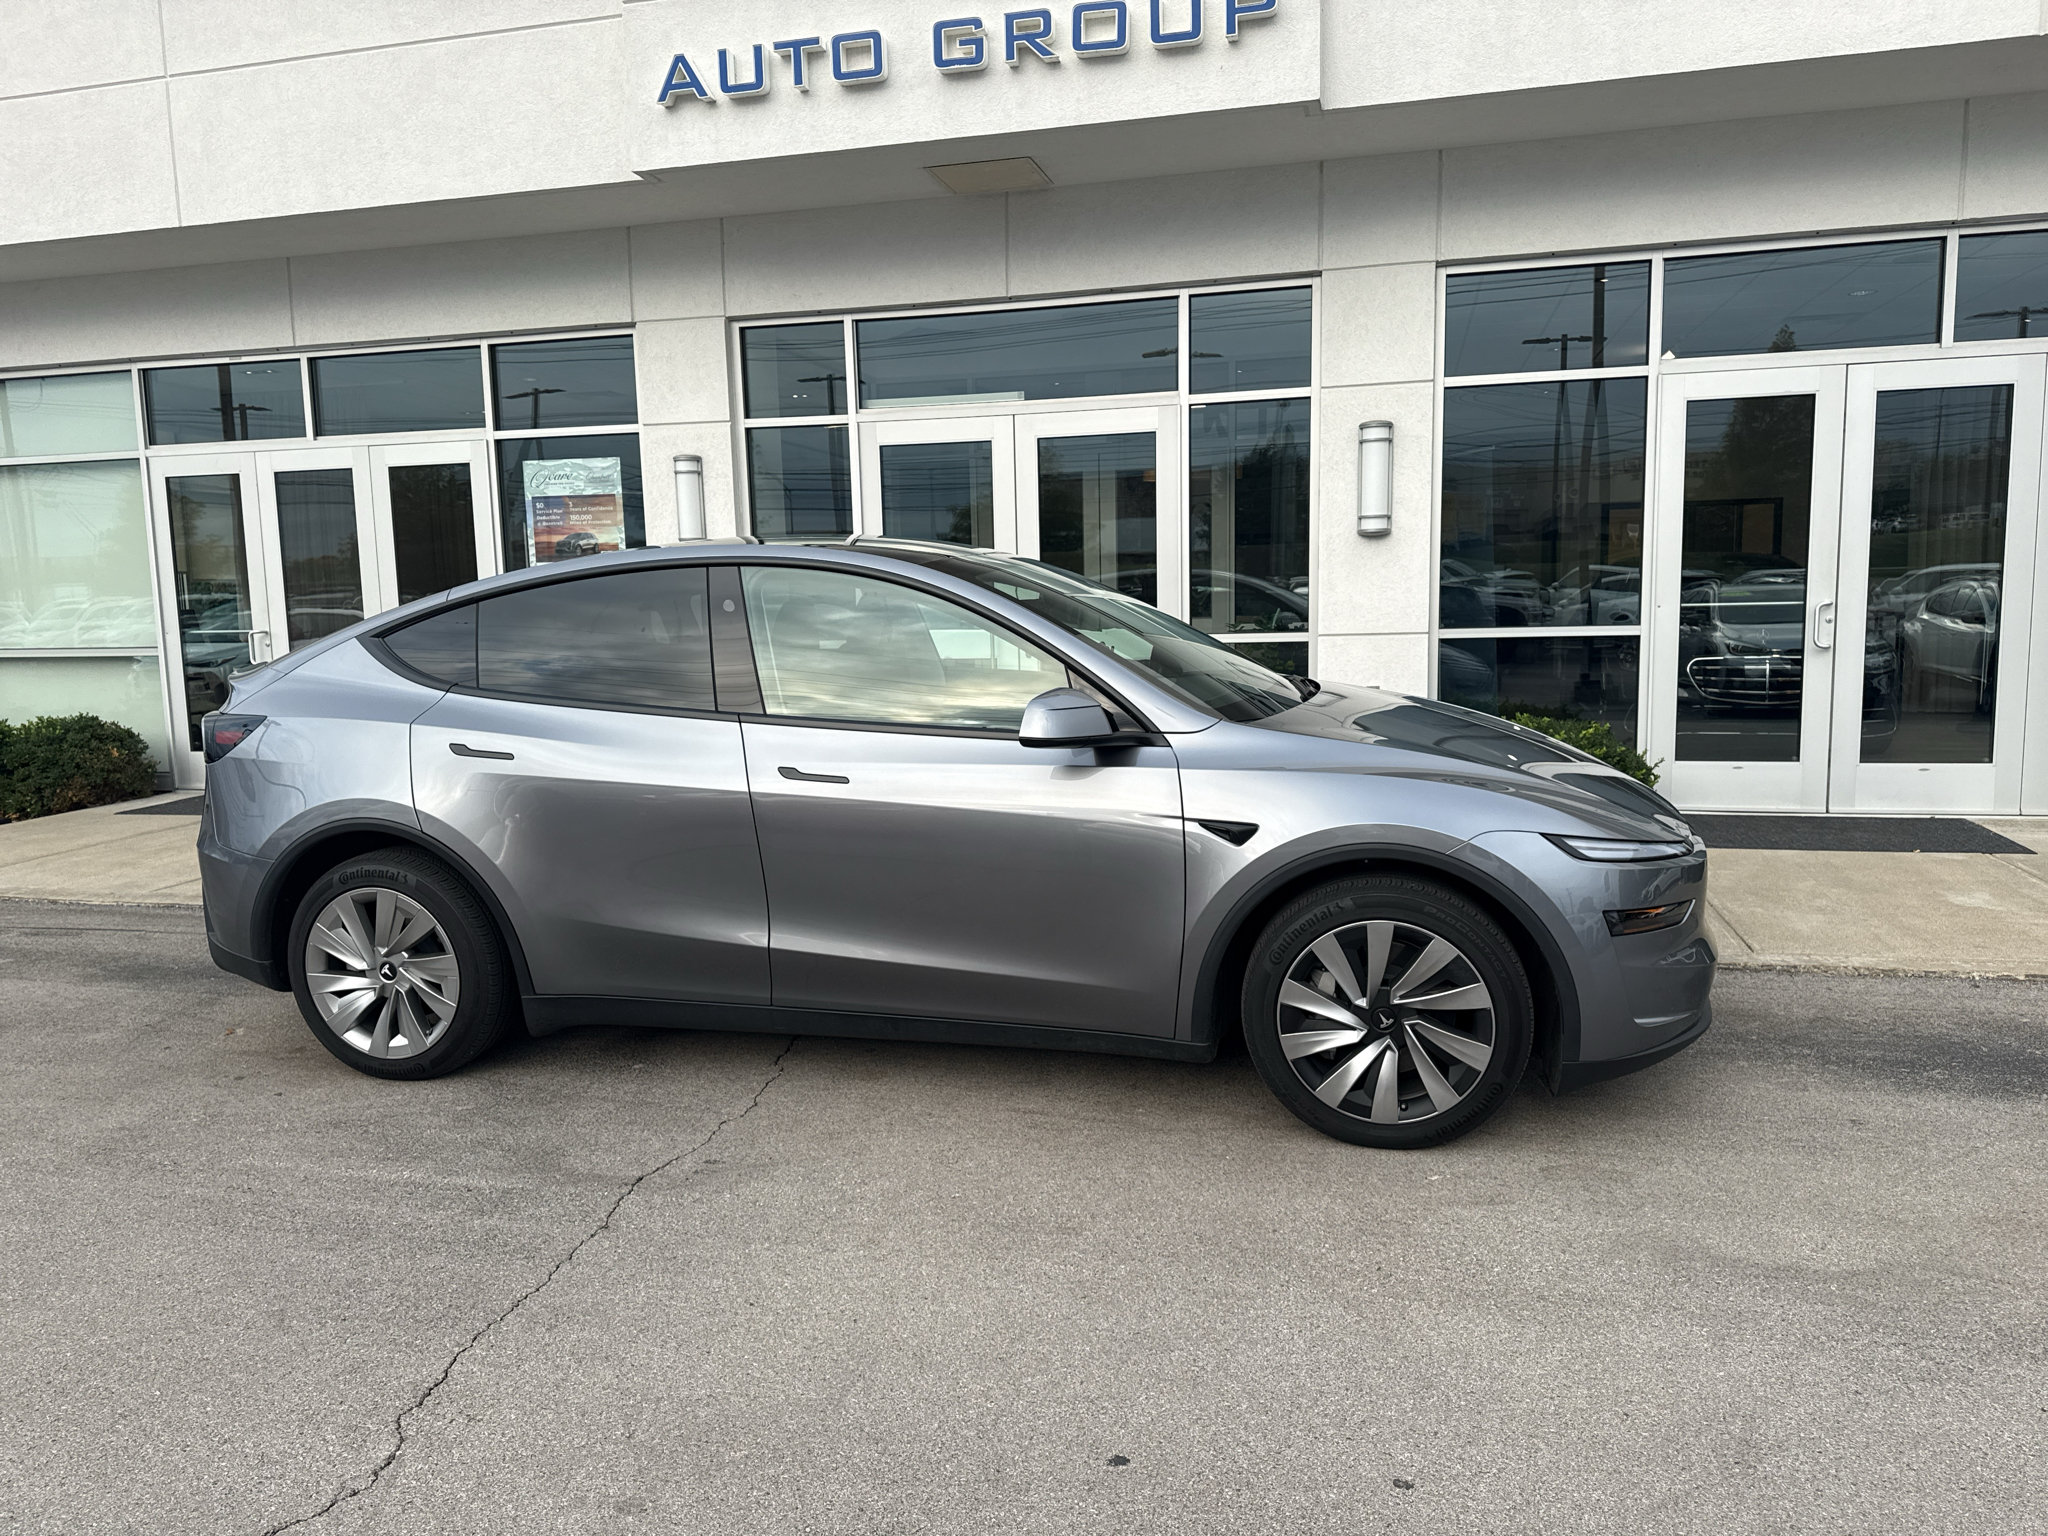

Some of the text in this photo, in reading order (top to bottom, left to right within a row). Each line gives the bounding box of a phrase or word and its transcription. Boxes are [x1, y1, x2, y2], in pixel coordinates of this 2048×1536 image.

[658, 0, 1276, 106] AUTO GROUP
[338, 867, 399, 885] Continental
[1269, 905, 1334, 966] Continental
